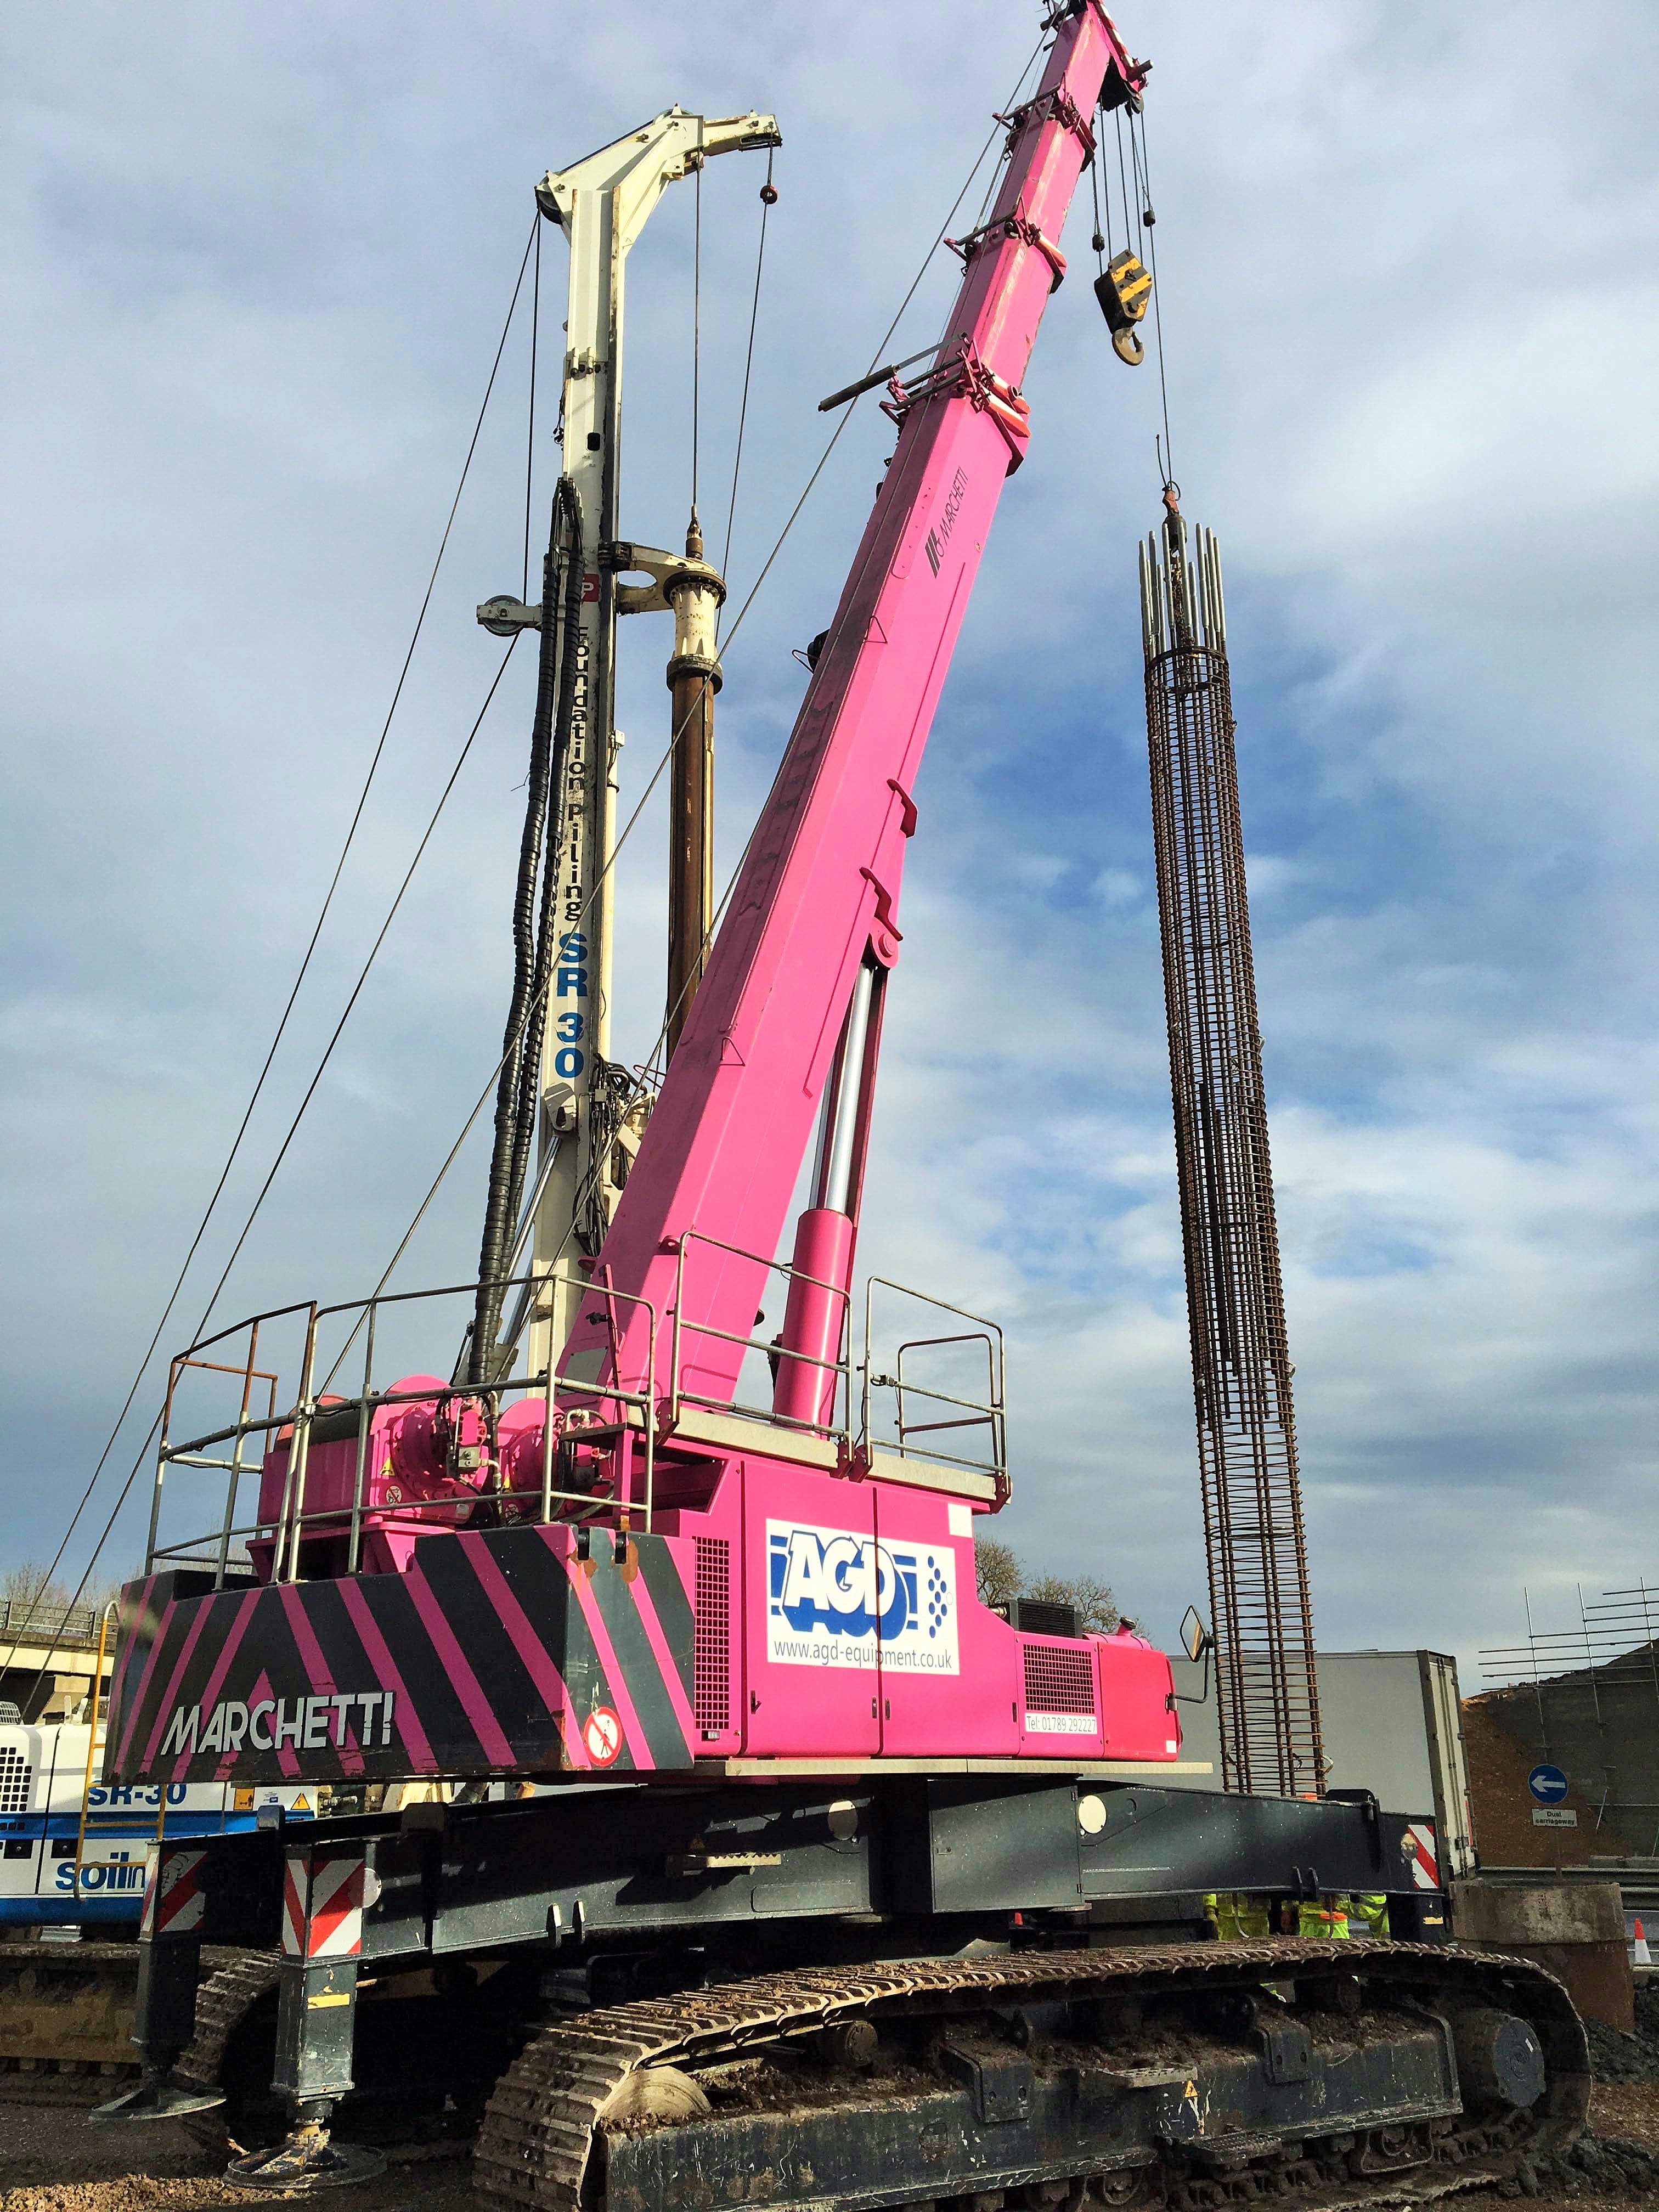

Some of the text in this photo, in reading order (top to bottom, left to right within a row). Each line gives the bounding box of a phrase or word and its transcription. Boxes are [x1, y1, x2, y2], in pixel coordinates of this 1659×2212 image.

[939, 466, 969, 546] MARCHETTI
[565, 803, 584, 922] Piling
[554, 932, 588, 1079] SR 30
[782, 1530, 903, 1630] AGD
[774, 1640, 952, 1669] www.agd-equipment.co.uk
[1026, 1716, 1096, 1733] Tel: 01789 292227
